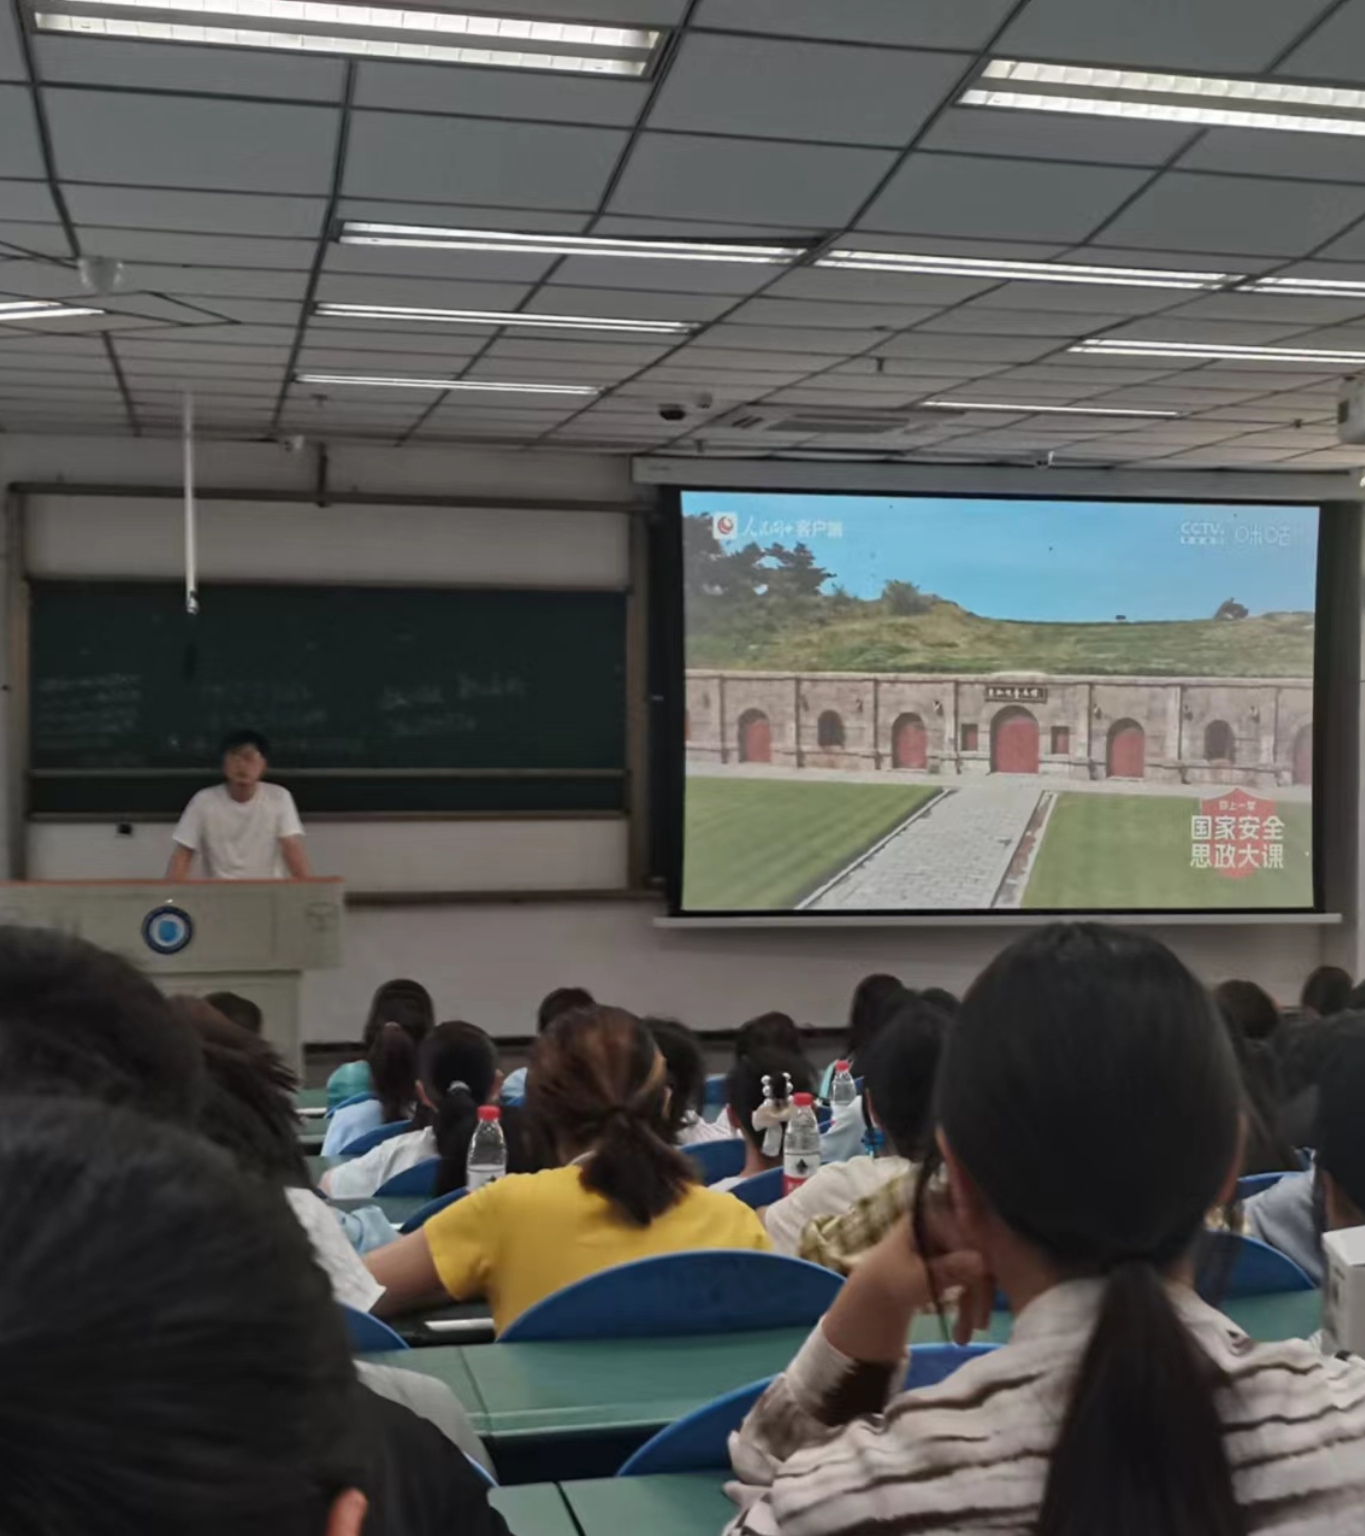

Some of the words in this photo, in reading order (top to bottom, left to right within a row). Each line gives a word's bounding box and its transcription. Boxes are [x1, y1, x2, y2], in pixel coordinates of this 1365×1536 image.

[1191, 815, 1286, 840] 国家安全
[1190, 843, 1285, 869] 思政大课
